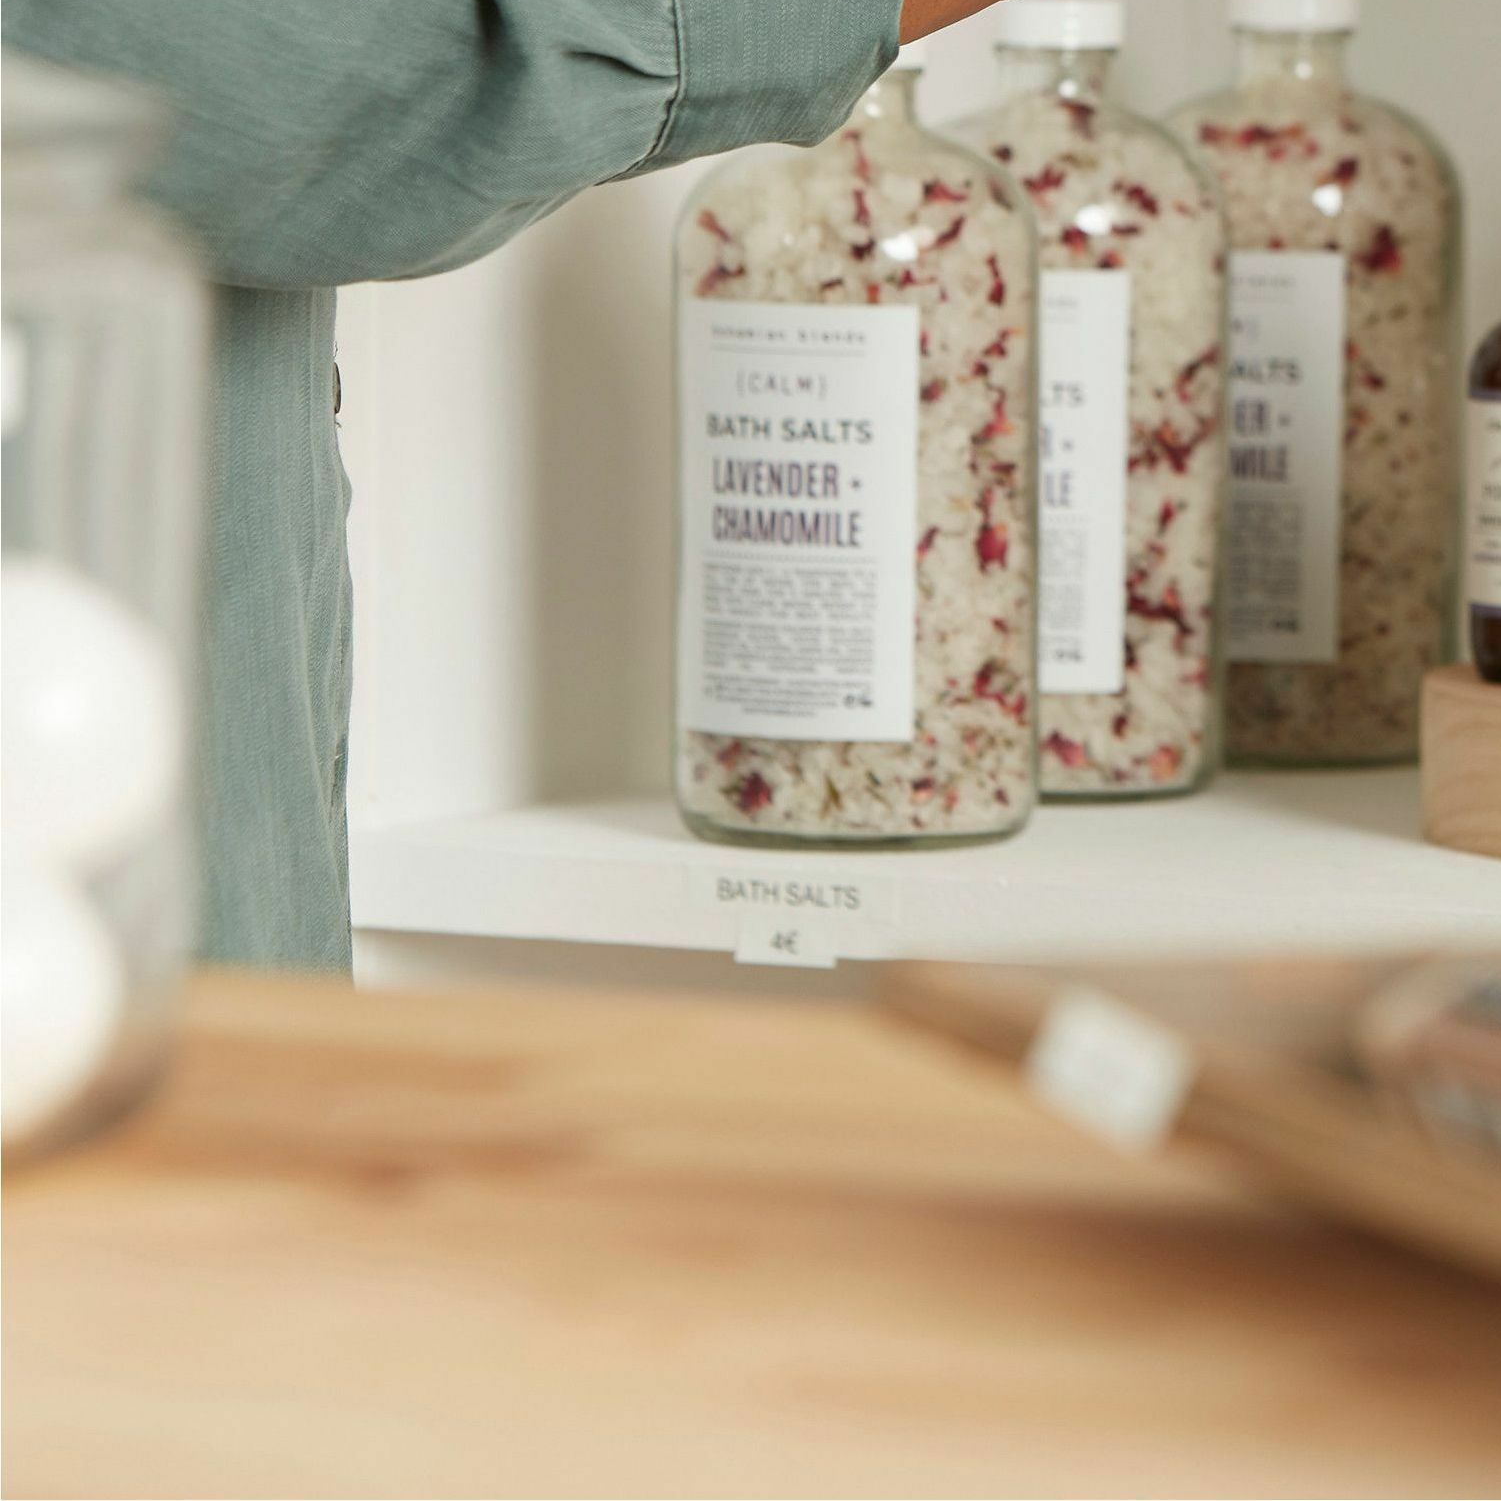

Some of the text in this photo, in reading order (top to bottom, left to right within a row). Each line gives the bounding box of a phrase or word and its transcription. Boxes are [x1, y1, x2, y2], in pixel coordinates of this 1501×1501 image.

[1230, 357, 1302, 386] ALTS
[706, 412, 874, 445] BATH SALTS
[712, 457, 839, 498] LAVENDER
[712, 504, 862, 548] CHAMOMILE
[716, 877, 860, 911] BATH SALTS
